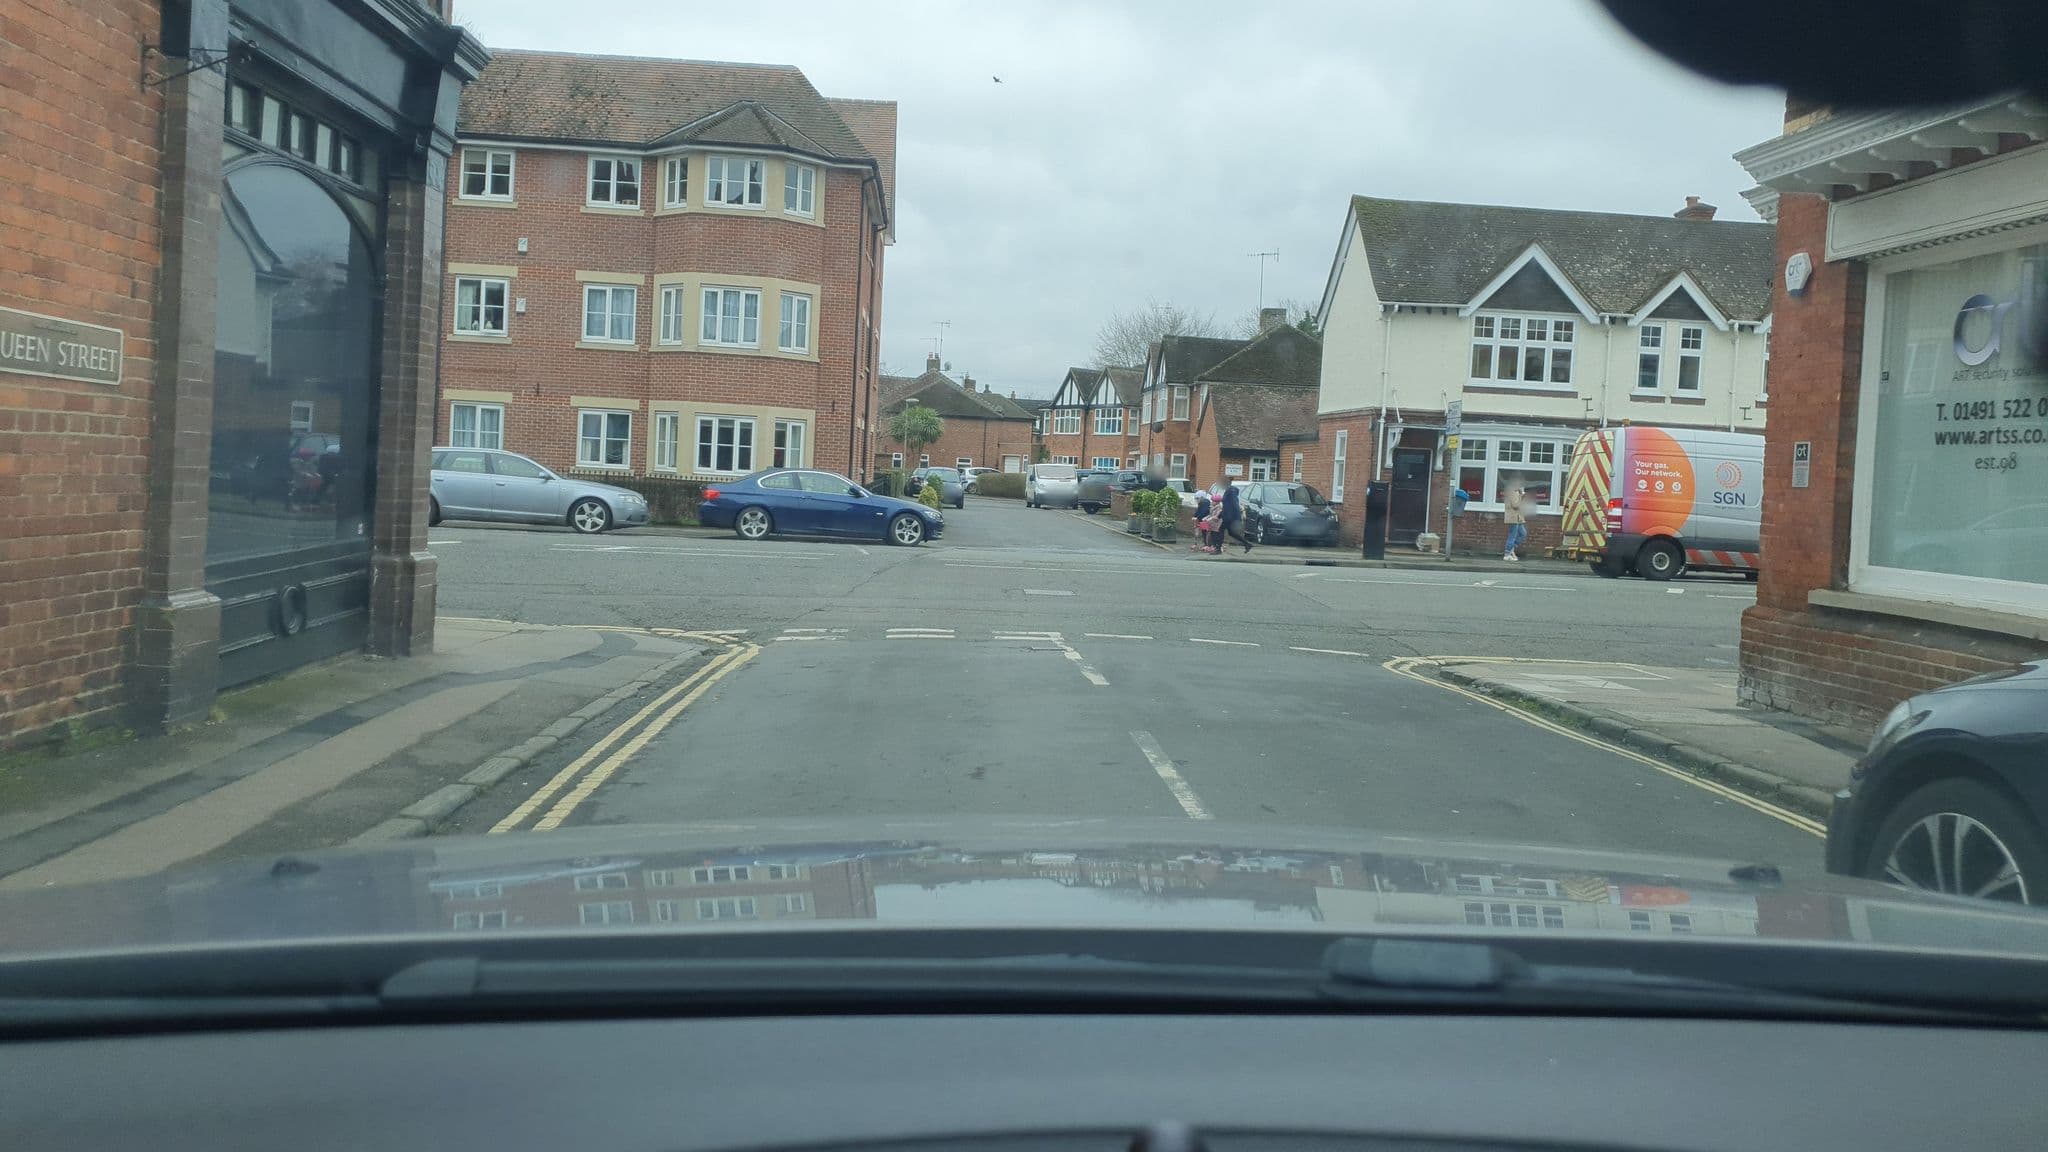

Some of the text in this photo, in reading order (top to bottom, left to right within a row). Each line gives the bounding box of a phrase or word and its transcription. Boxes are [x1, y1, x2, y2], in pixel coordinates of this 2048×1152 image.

[58, 341, 118, 372] STREET
[1936, 403, 1948, 421] T.
[1953, 401, 1996, 421] 01491
[2003, 398, 2031, 418] 522
[1635, 460, 1653, 468] Your
[1650, 470, 1683, 478] network.
[1713, 491, 1746, 505] SGN
